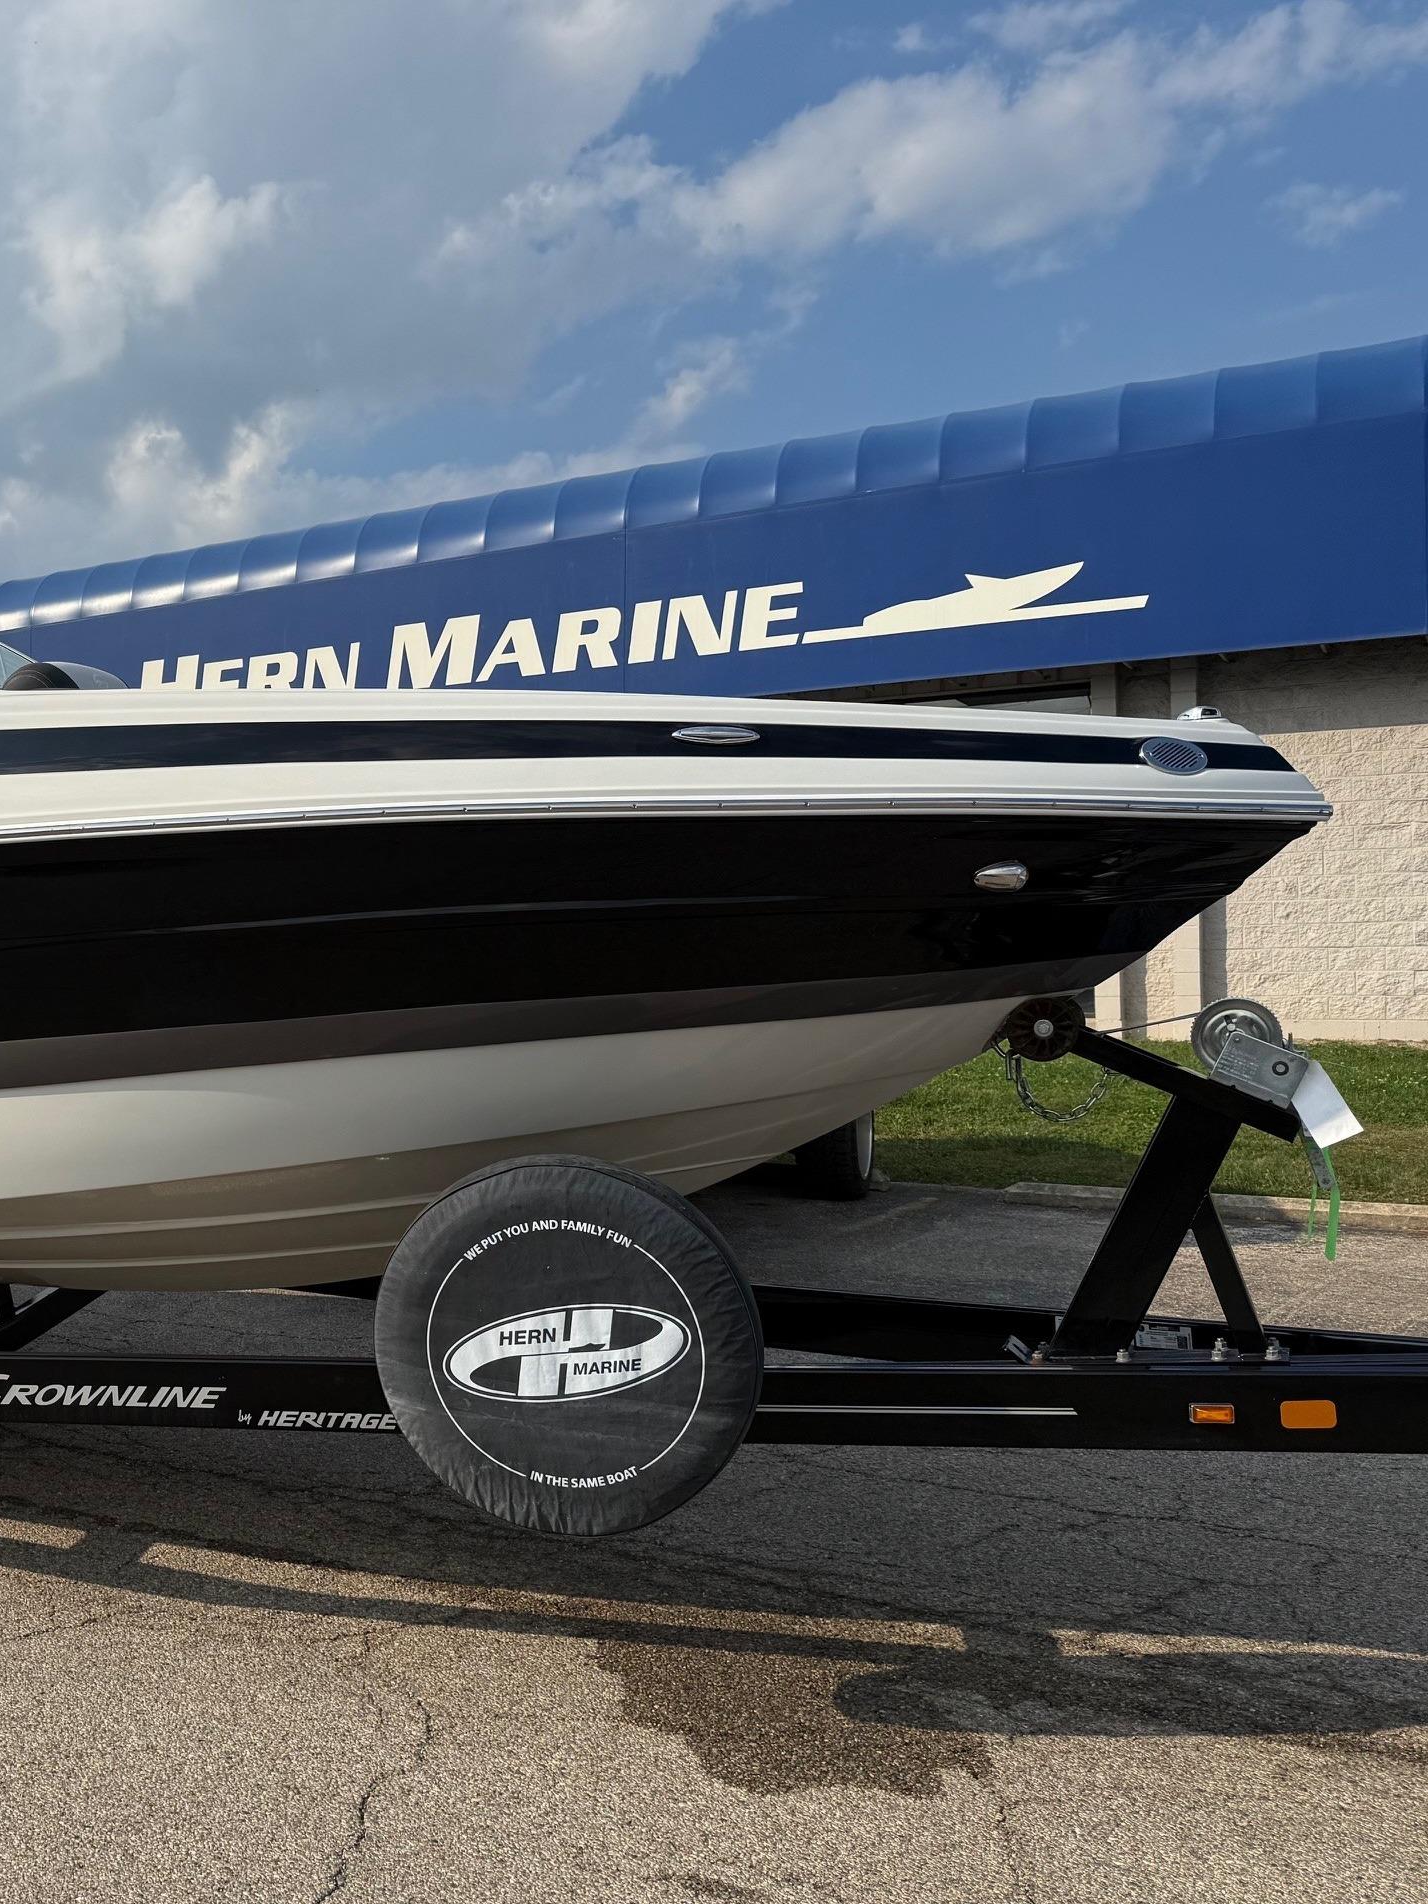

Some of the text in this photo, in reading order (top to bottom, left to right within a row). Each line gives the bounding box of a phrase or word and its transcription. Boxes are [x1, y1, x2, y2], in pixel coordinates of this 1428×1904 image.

[386, 581, 804, 690] MARINE
[463, 1219, 633, 1261] WE PUT YOU AND FAMILY FUN
[499, 1327, 557, 1346] HERN
[573, 1358, 642, 1376] MARINE
[238, 1409, 397, 1430] by HERITAGE
[529, 1465, 638, 1489] IN THE SAME BOAT
